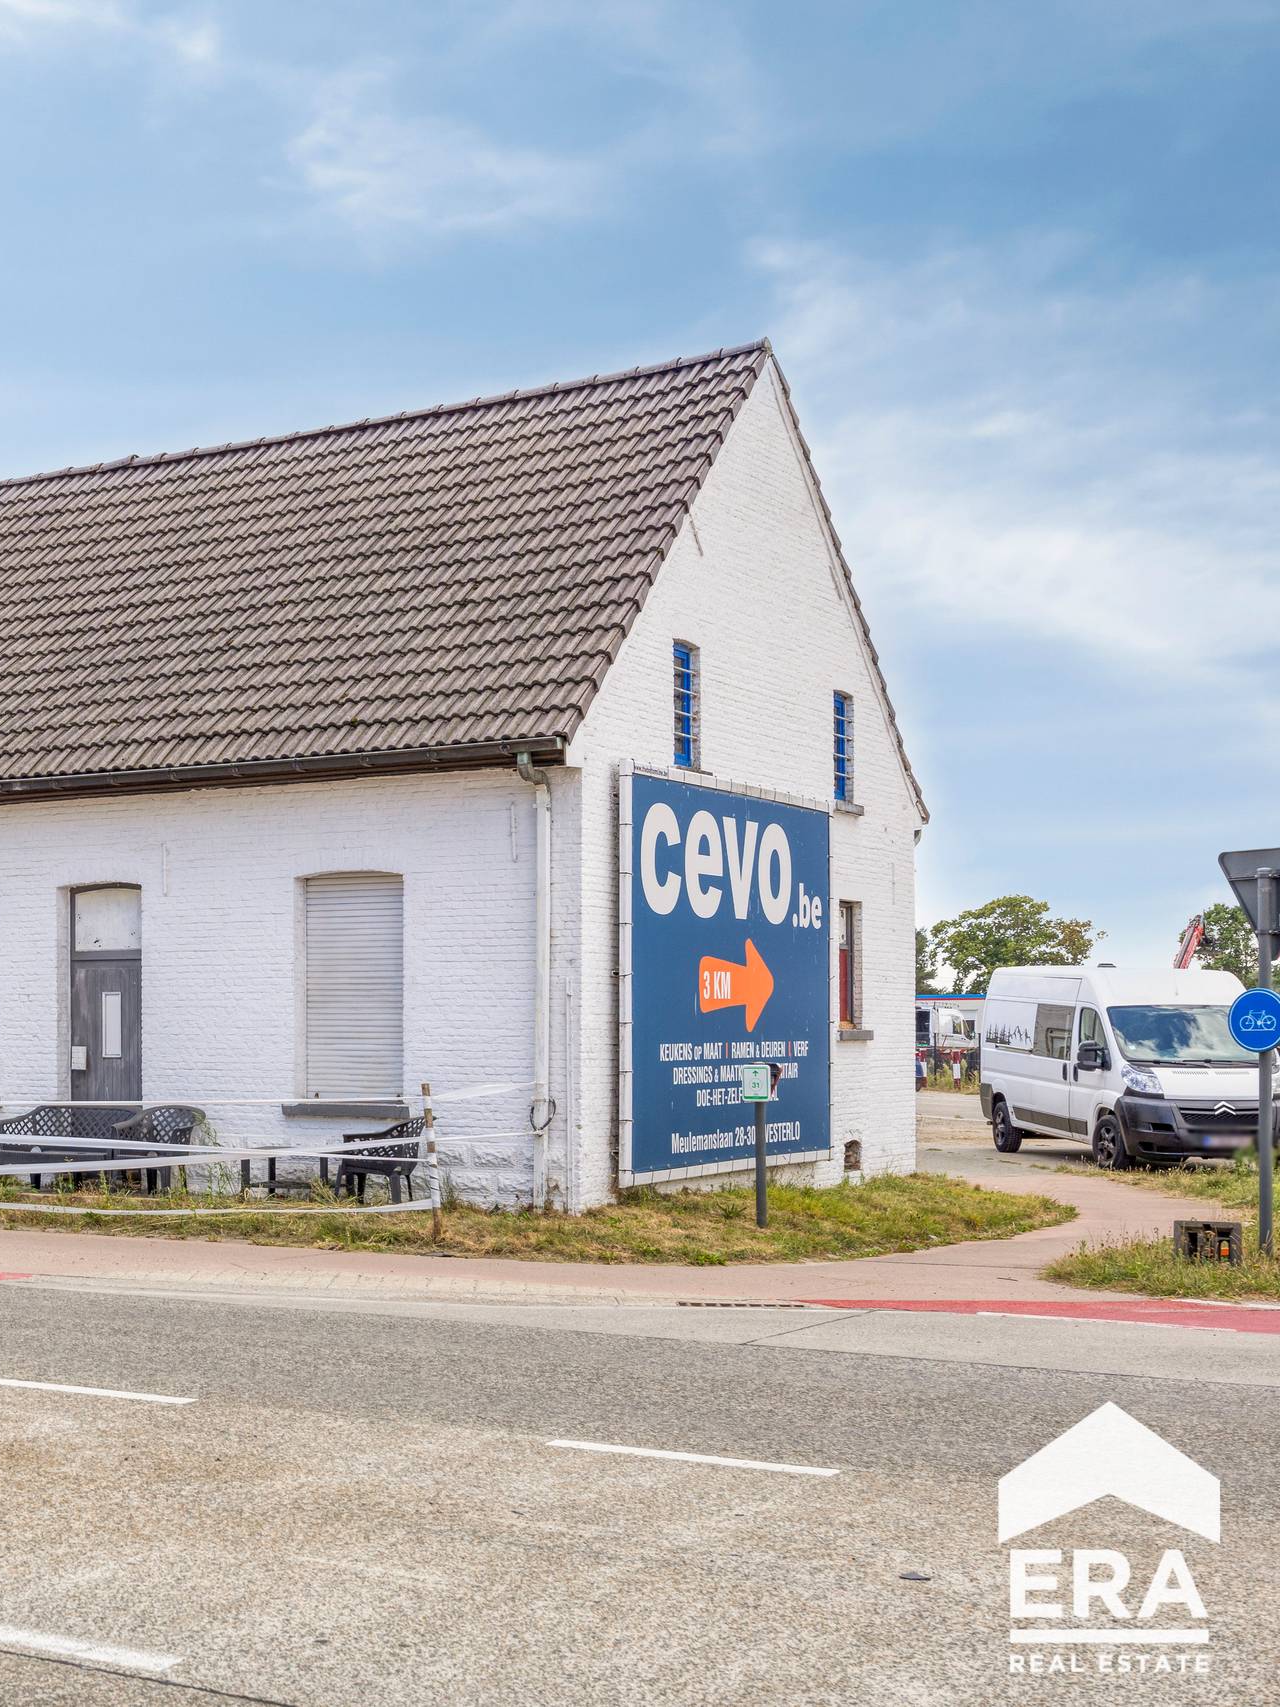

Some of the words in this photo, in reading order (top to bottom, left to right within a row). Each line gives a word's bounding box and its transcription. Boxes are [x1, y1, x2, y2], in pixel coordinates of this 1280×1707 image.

[703, 970, 710, 1000] 3
[713, 970, 731, 1000] KM
[659, 1042, 693, 1061] KEUKENS
[703, 1042, 723, 1060] MAAT
[731, 1041, 755, 1059] RAMEN
[755, 1044, 760, 1058] &
[761, 1041, 786, 1058] DEUREN
[793, 1040, 809, 1057] VERF
[673, 1065, 713, 1084] DRESSINGS
[714, 1068, 719, 1082] &
[720, 1065, 743, 1082] MAATK
[751, 1081, 760, 1089] 31
[671, 1129, 733, 1154] Meulemanslaan
[734, 1125, 756, 1147] 28-30
